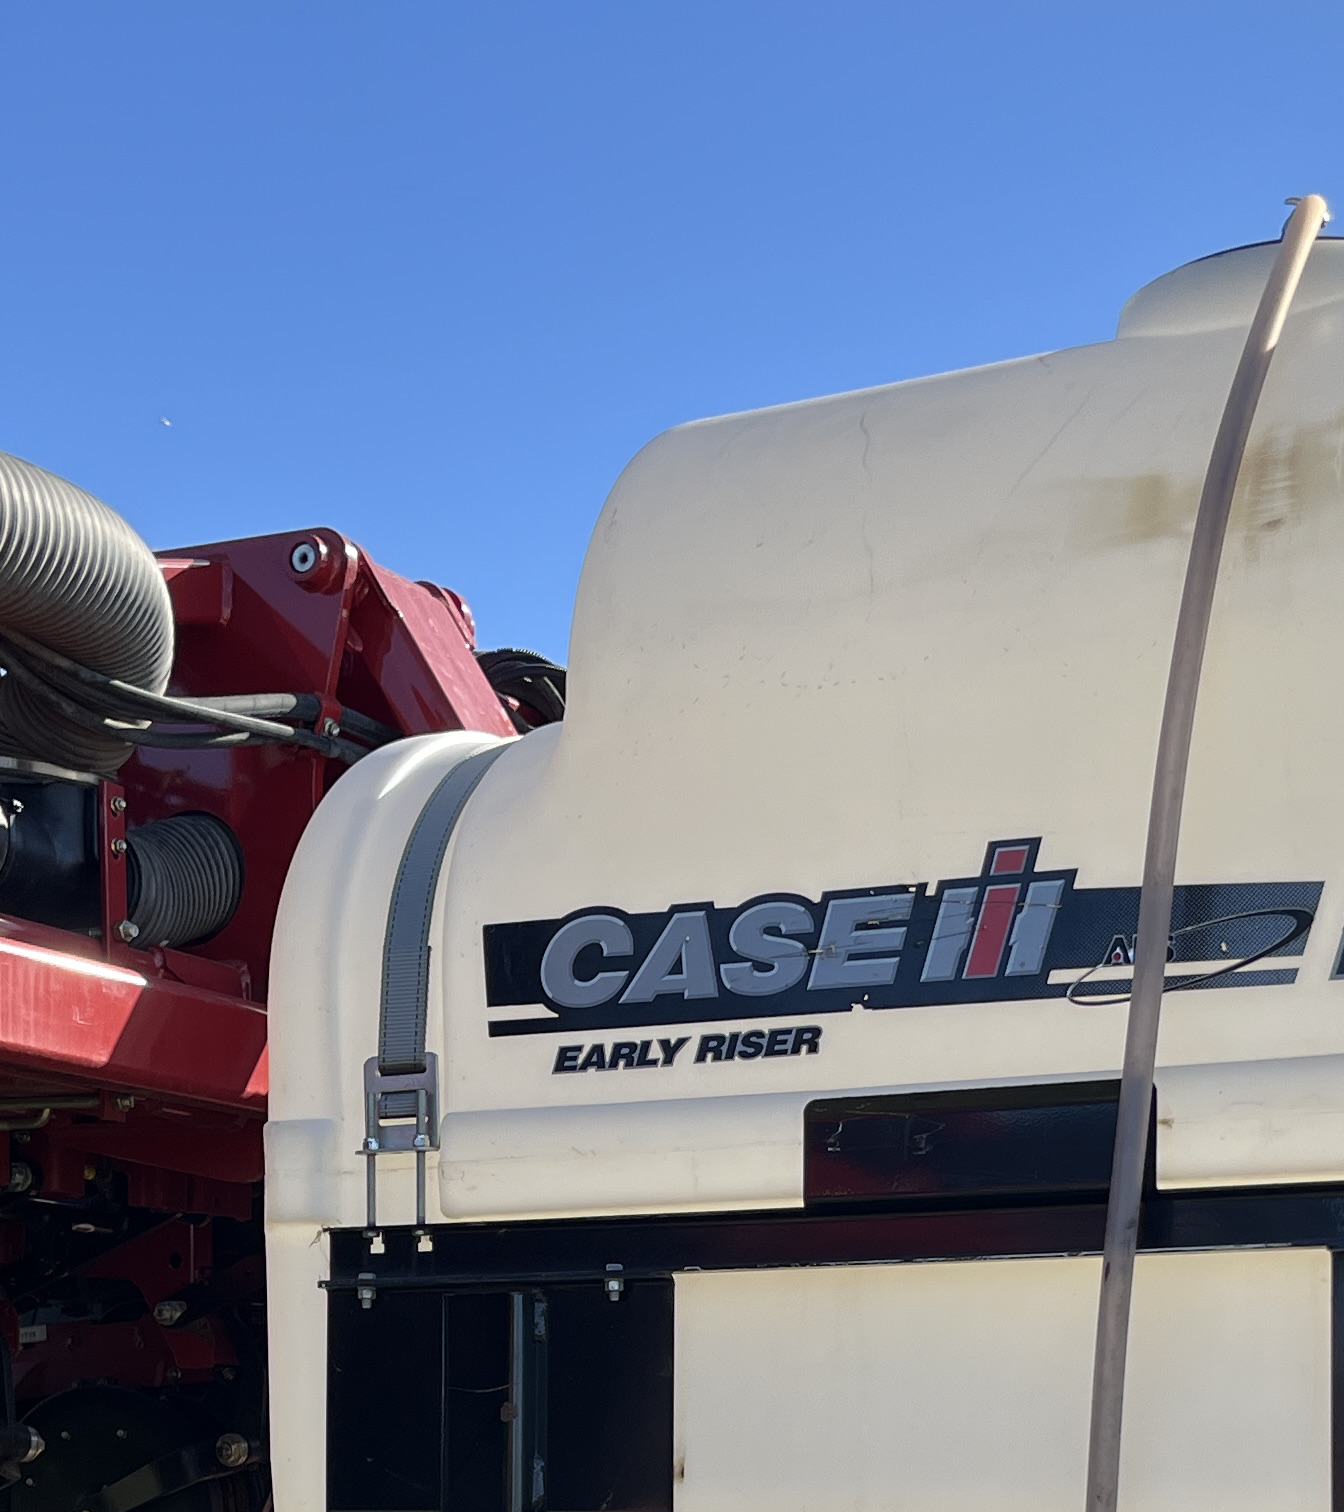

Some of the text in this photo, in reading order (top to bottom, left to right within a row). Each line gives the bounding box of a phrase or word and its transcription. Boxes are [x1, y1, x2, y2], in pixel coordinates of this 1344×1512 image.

[540, 892, 916, 1009] CASE
[551, 1024, 823, 1075] EARLY RISER
